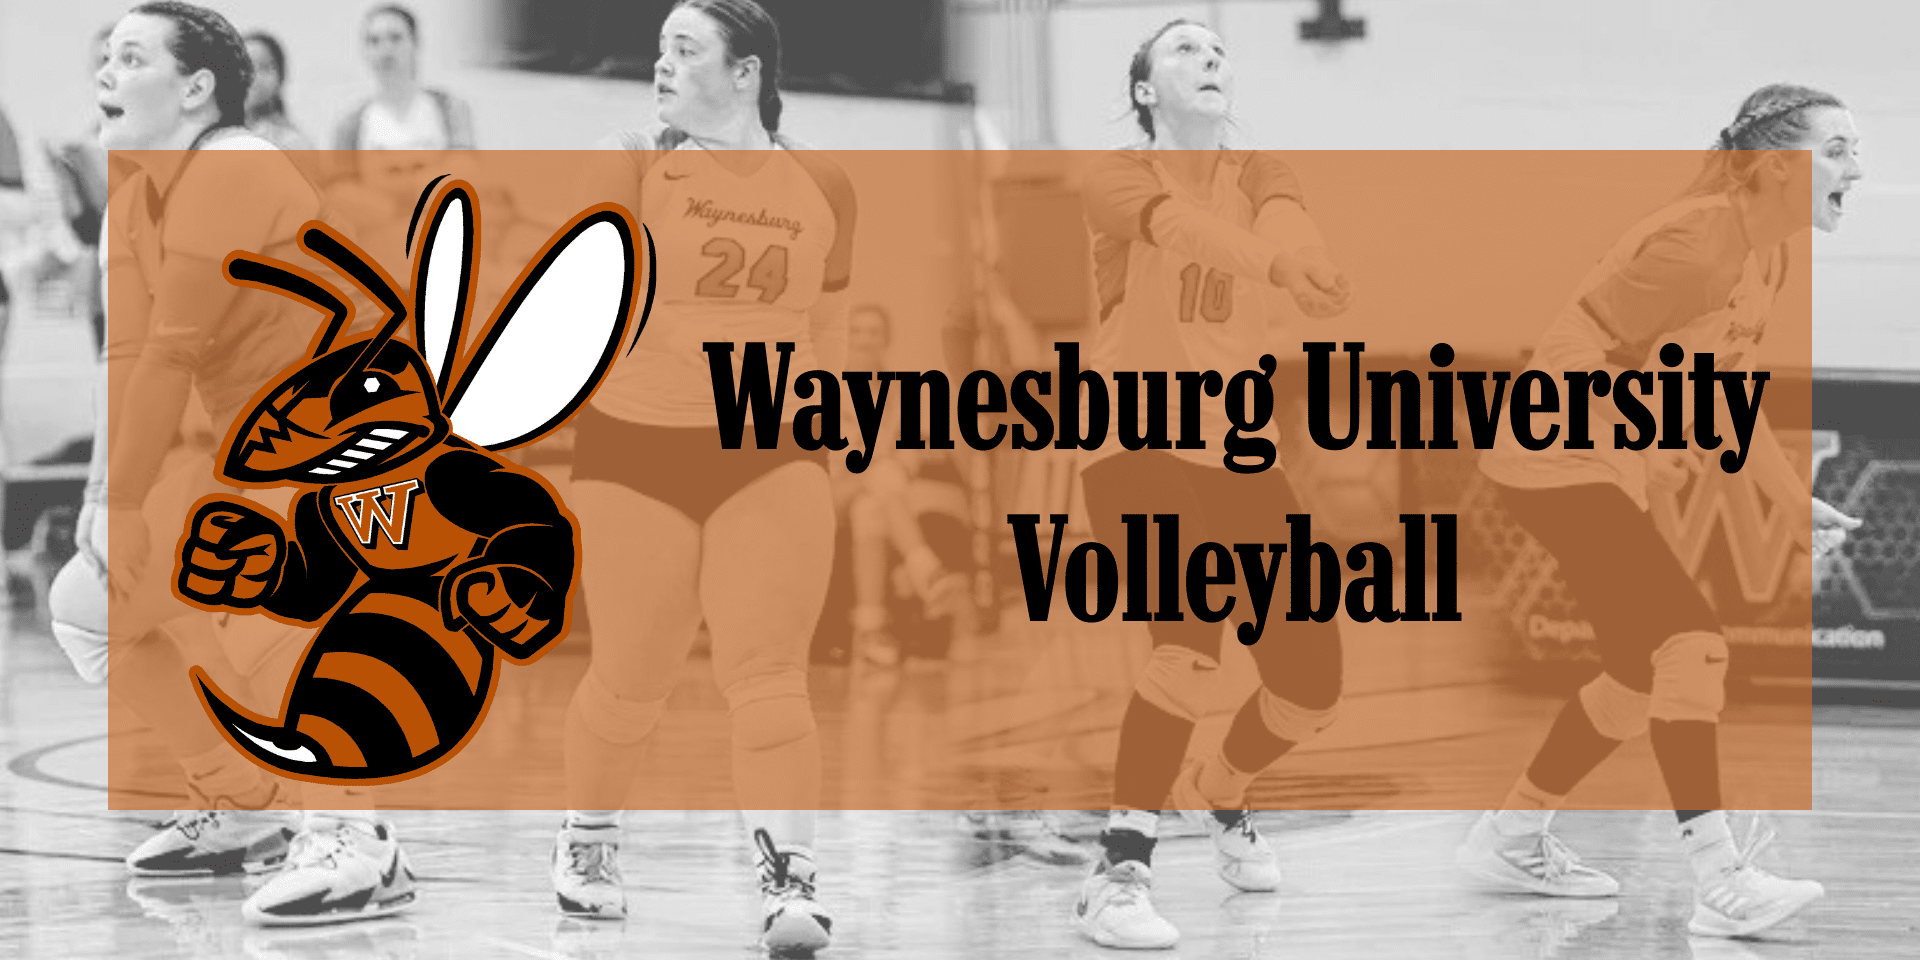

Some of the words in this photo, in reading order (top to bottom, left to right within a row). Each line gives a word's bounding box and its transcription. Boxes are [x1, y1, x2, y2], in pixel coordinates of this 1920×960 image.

[683, 197, 803, 240] Waynesburg
[694, 237, 788, 305] 24
[1179, 261, 1234, 323] 10
